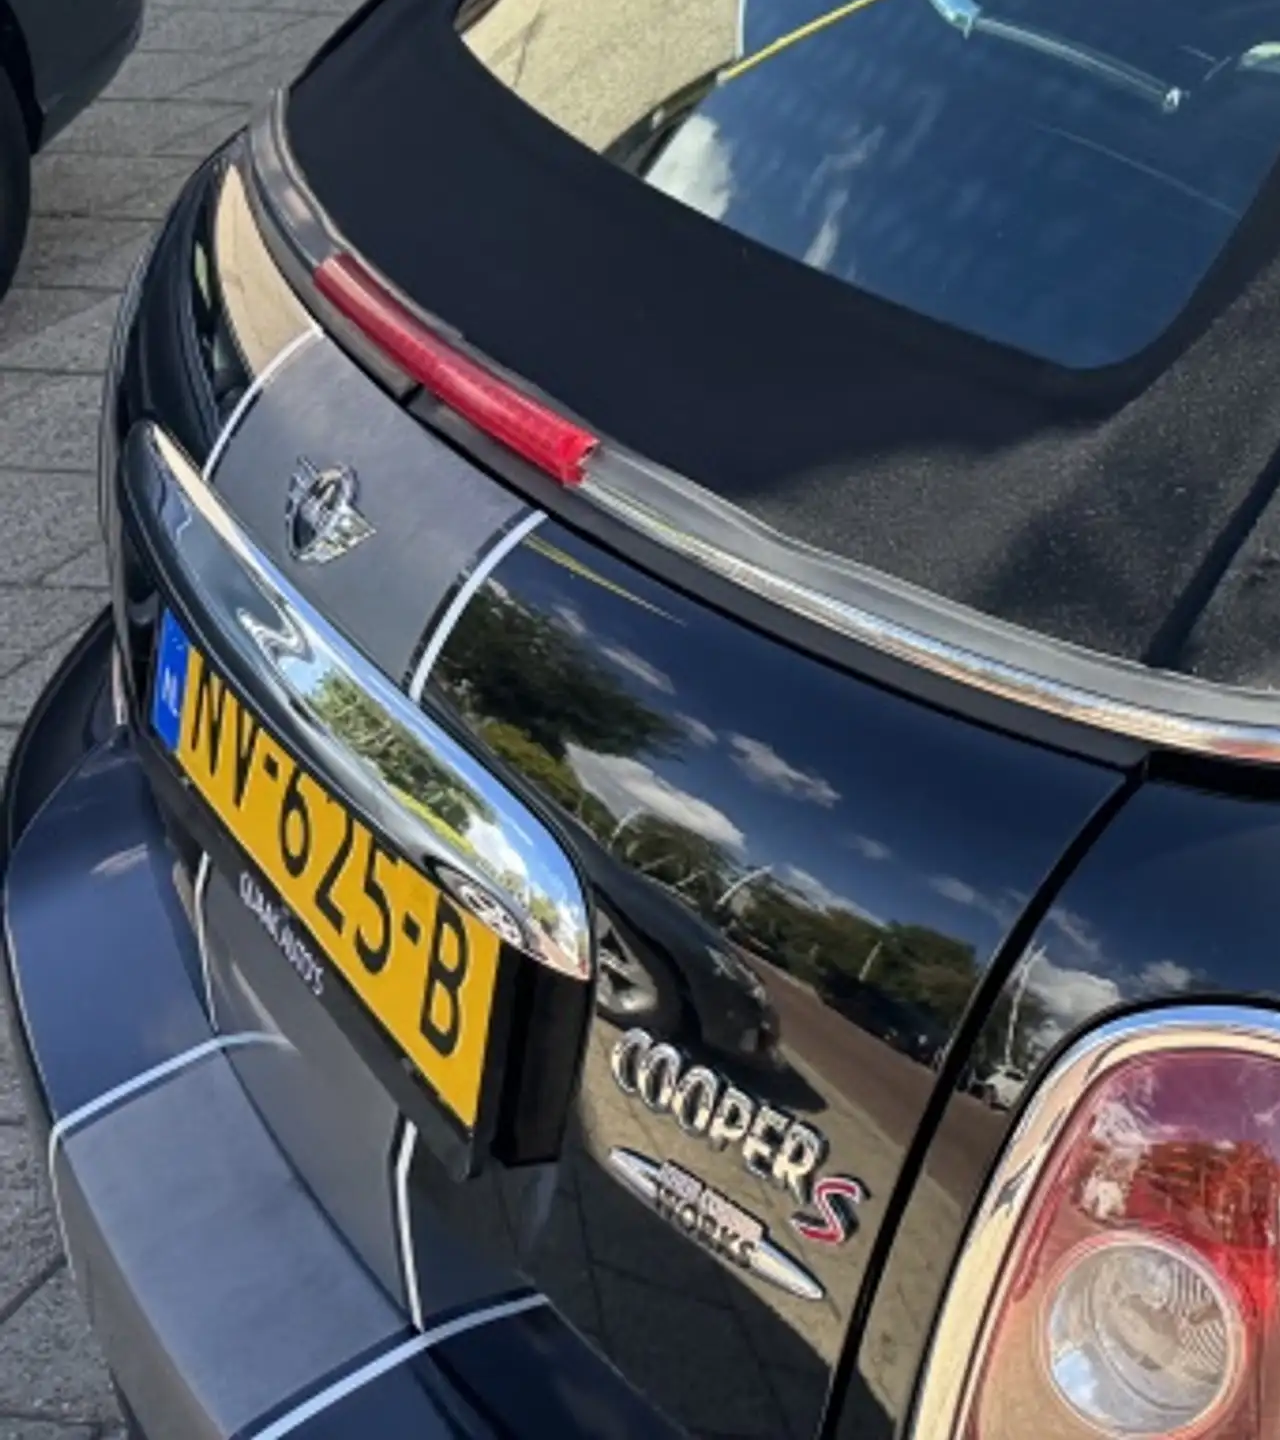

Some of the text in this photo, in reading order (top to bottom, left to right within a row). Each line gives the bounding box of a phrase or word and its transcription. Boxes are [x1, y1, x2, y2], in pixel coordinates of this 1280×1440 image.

[190, 664, 470, 1059] NV-625-B
[610, 1027, 824, 1210] COOPER
[788, 1175, 864, 1246] S
